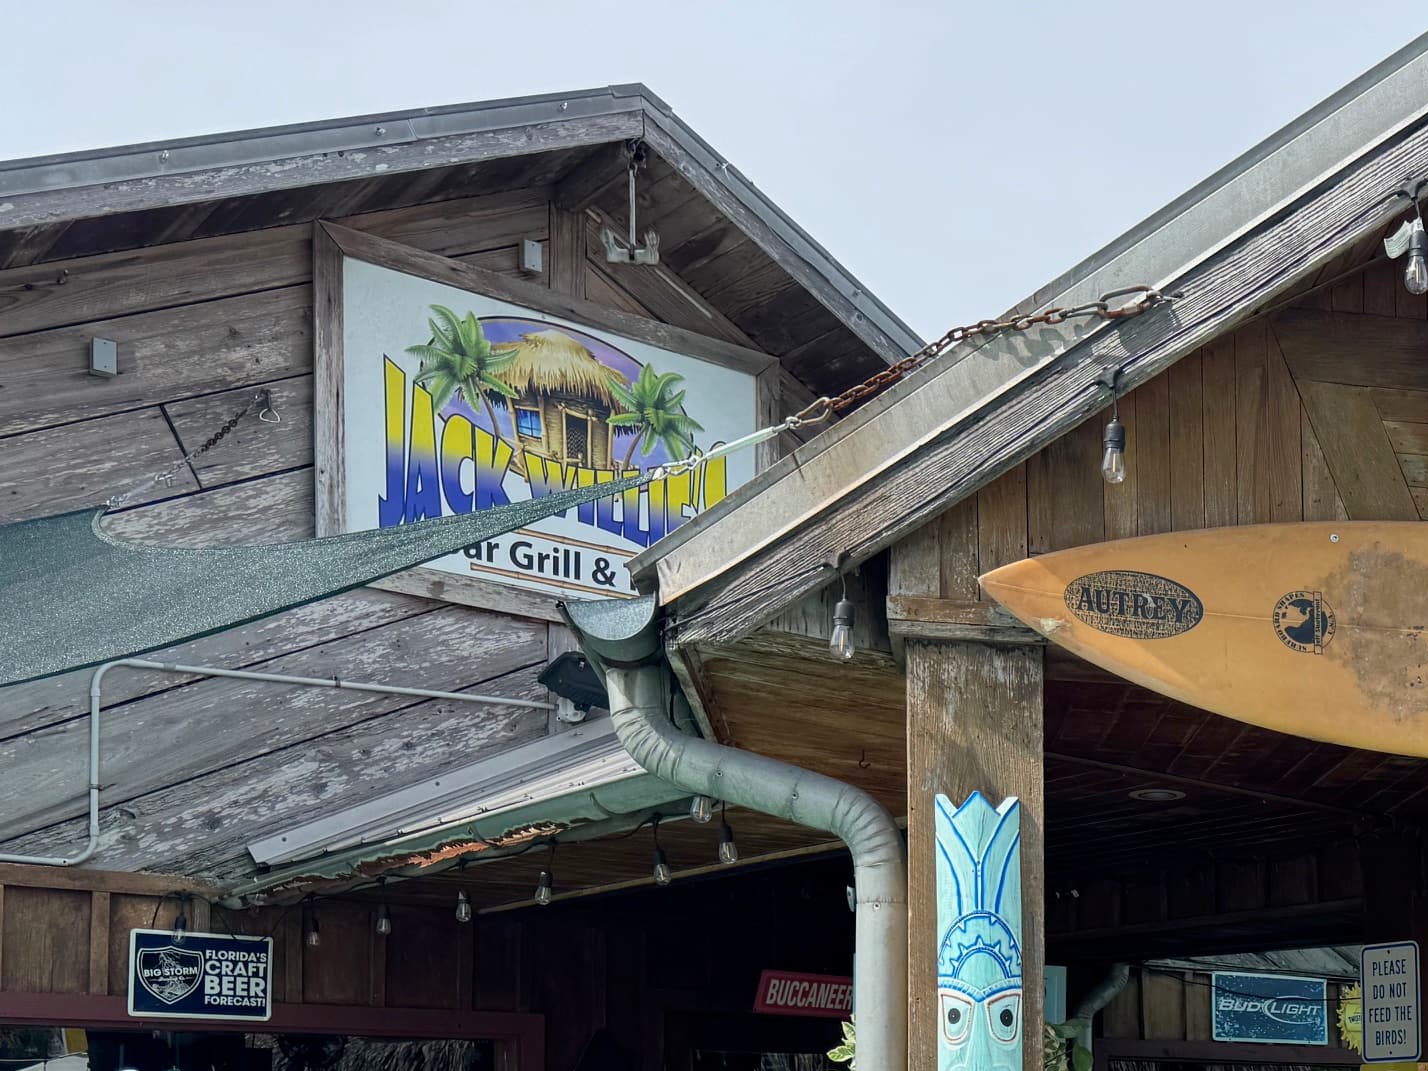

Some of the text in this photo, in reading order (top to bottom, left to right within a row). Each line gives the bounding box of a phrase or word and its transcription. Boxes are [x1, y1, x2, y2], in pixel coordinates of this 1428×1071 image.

[379, 354, 513, 529] JACK
[509, 541, 581, 581] Grill
[591, 557, 616, 588] &
[1076, 586, 1190, 623] AUTREY
[205, 949, 267, 962] FLORIDA'S
[144, 967, 199, 977] BIG STORM
[205, 961, 266, 977] CRAFT
[1372, 959, 1407, 977] PLEASE
[204, 975, 266, 997] BEER
[1373, 982, 1407, 1000] DO NOT
[204, 995, 266, 1007] FORECAST!
[1219, 999, 1322, 1016] BUD LIGHT
[1368, 1005, 1412, 1023] FEED THE
[1375, 1029, 1407, 1046] BIRDS!
